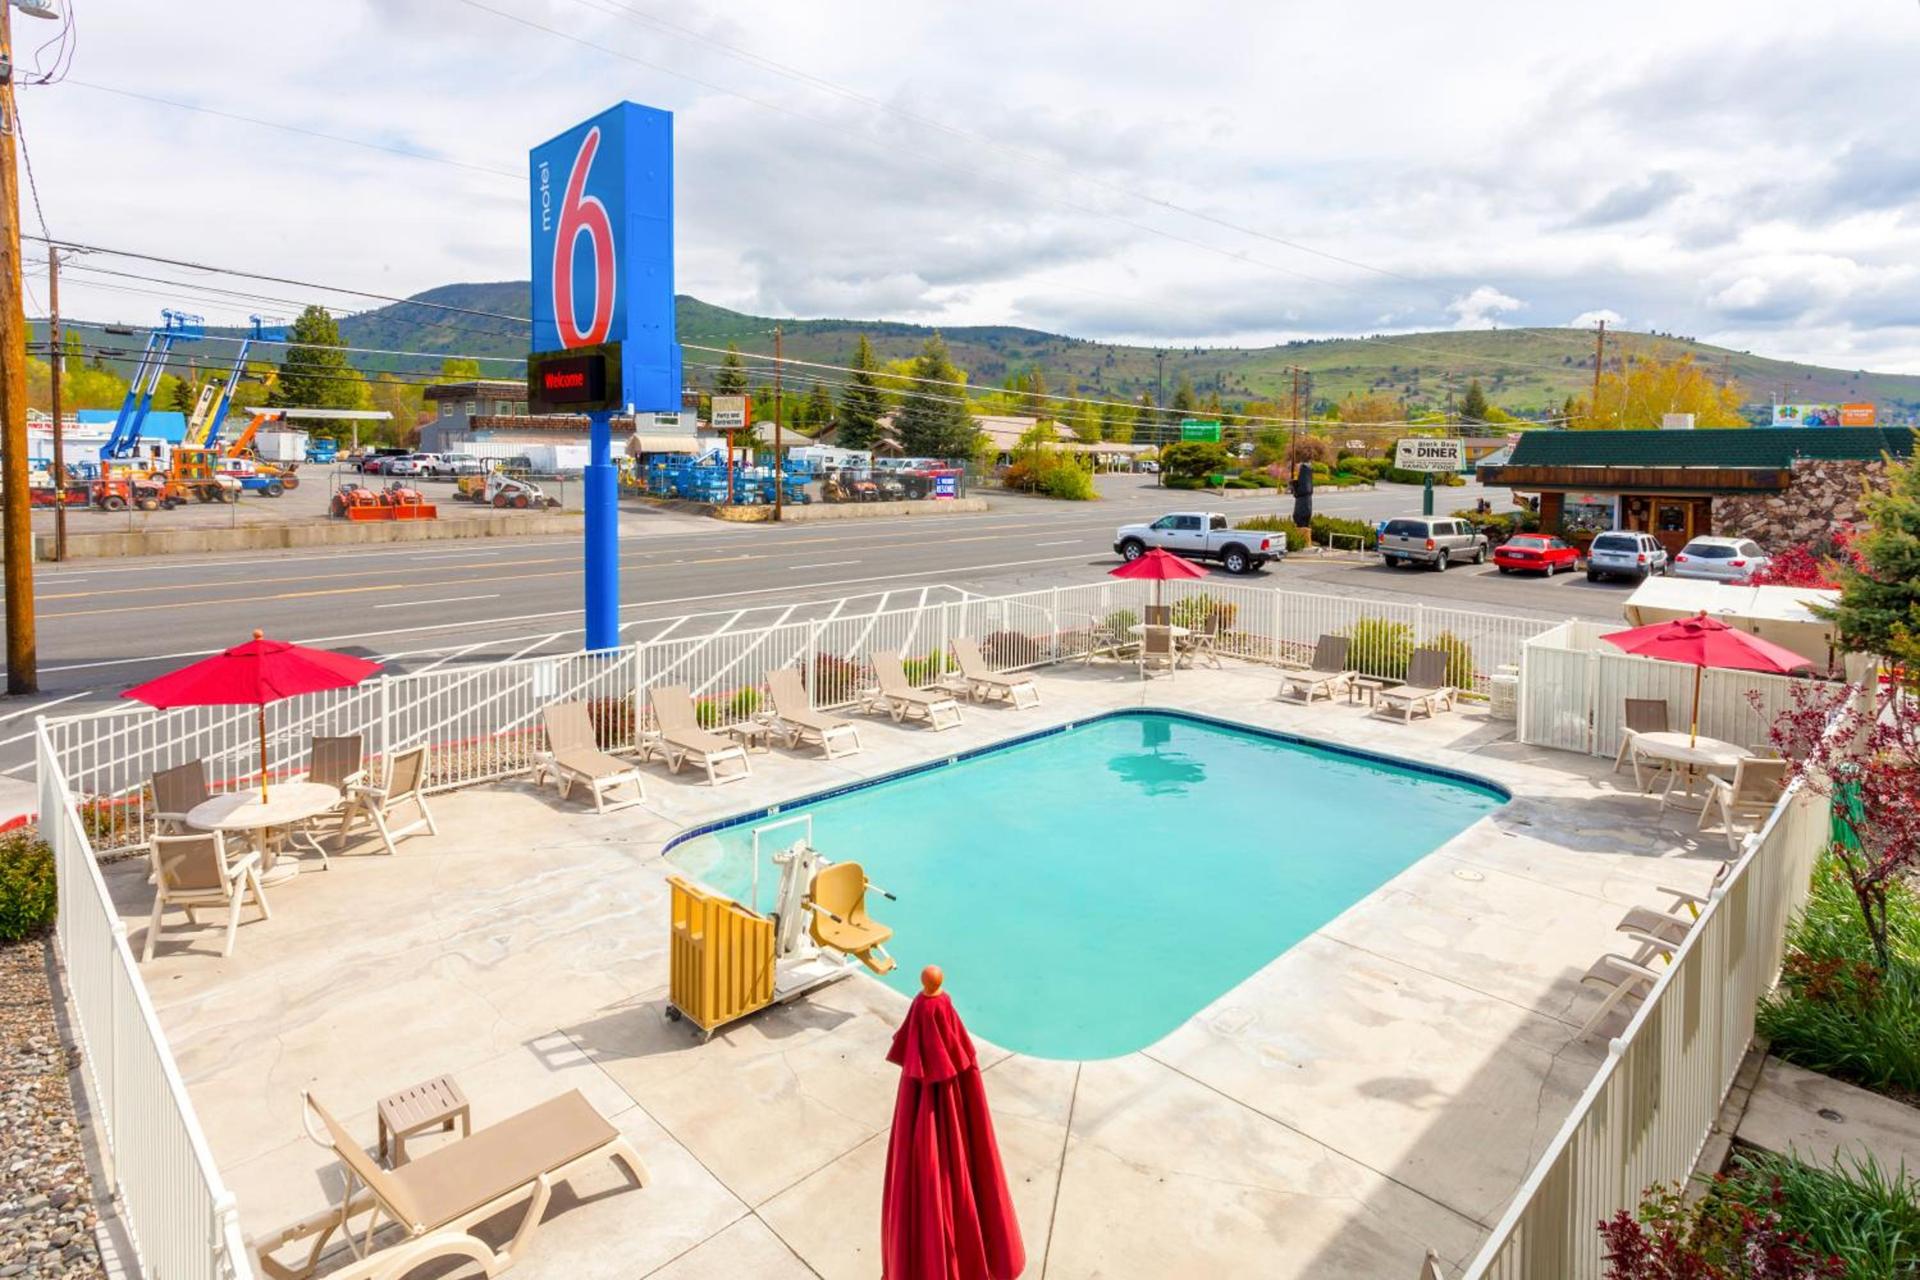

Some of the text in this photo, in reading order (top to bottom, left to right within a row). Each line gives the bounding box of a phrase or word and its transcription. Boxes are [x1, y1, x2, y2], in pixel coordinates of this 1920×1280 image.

[538, 160, 551, 232] motel
[552, 126, 616, 350] 6
[545, 372, 584, 389] Welcome
[1417, 448, 1458, 459] DINER
